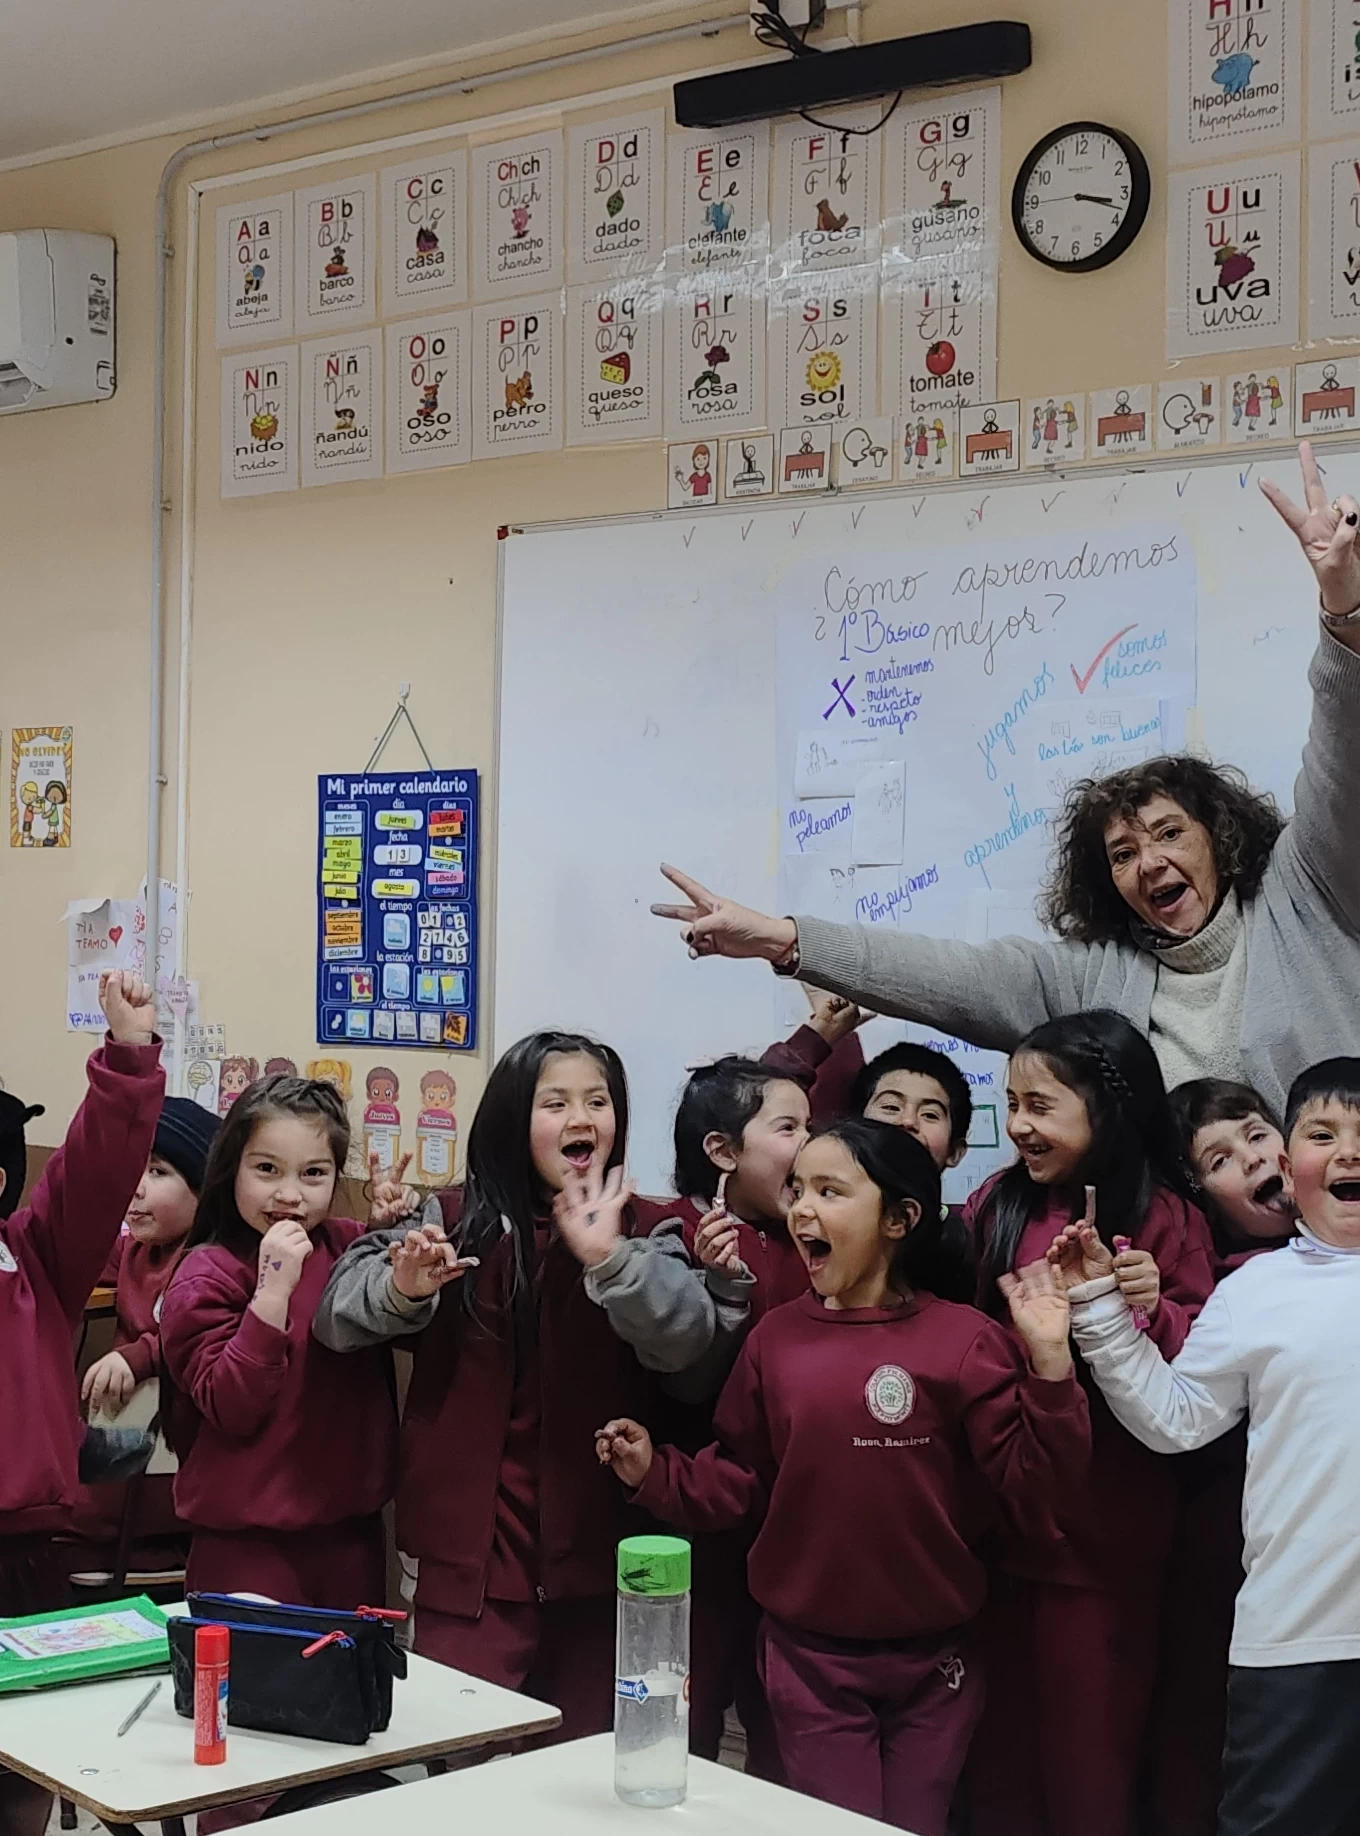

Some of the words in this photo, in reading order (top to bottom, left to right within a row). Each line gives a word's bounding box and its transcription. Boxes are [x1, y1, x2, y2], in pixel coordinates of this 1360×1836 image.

[1193, 80, 1279, 111] hipopótamo
[920, 121, 941, 144] G
[952, 113, 970, 138] g
[598, 141, 614, 163] D
[624, 135, 638, 158] d
[1075, 139, 1088, 156] 12
[1056, 150, 1065, 165] 11
[498, 162, 518, 181] Ch
[522, 157, 540, 176] ch
[1114, 161, 1123, 176] 2
[1039, 171, 1051, 186] 10
[1031, 195, 1039, 209] 9
[1120, 186, 1128, 200] 3
[321, 203, 334, 222] B
[342, 199, 352, 218] b
[912, 205, 980, 232] gusano
[596, 217, 640, 237] dado
[1035, 220, 1044, 234] 8
[1111, 213, 1119, 228] 4
[689, 228, 747, 249] elefante
[799, 225, 861, 245] foca
[912, 224, 980, 255] gusano
[1051, 237, 1059, 250] 7
[1094, 233, 1102, 247] 5
[498, 236, 543, 257] chancho
[593, 237, 643, 255] dado
[802, 243, 858, 266] foca
[1072, 241, 1080, 255] 6
[406, 252, 444, 270] casa
[498, 254, 542, 272] chancho
[319, 275, 354, 291] barco
[406, 268, 445, 284] casa
[236, 292, 268, 306] abeja
[319, 291, 355, 306] barco
[1197, 277, 1270, 305] uva
[1203, 305, 1262, 328] uva
[910, 369, 974, 392] tomate
[588, 385, 644, 404] queso
[688, 381, 738, 400] rosa
[800, 384, 845, 406] sol
[588, 400, 642, 421] queso
[692, 398, 738, 415] rosa
[910, 390, 970, 413] tomate
[407, 411, 451, 430] oso
[493, 401, 546, 422] perro
[803, 403, 850, 423] sol
[316, 425, 369, 445] ñandú
[409, 428, 452, 445] oso
[493, 417, 540, 440] perro
[236, 439, 284, 456] nido
[318, 443, 366, 460] ñandú
[240, 457, 279, 472] nido
[825, 565, 928, 613] Cómo
[951, 535, 1181, 624] aprendemos
[1118, 629, 1167, 657] somos
[1102, 657, 1161, 689] felices
[976, 661, 1055, 781] jugamos
[327, 779, 345, 795] Mi
[350, 781, 396, 800] primer
[399, 776, 467, 794] calendario
[789, 809, 806, 828] no
[796, 802, 851, 852] peleamos
[333, 824, 355, 833] febrero
[388, 831, 408, 845] fecha
[389, 868, 403, 877] mes
[870, 864, 939, 922] empujamos
[388, 902, 412, 913] tiempo
[856, 892, 878, 920] no
[328, 948, 358, 957] diciembre
